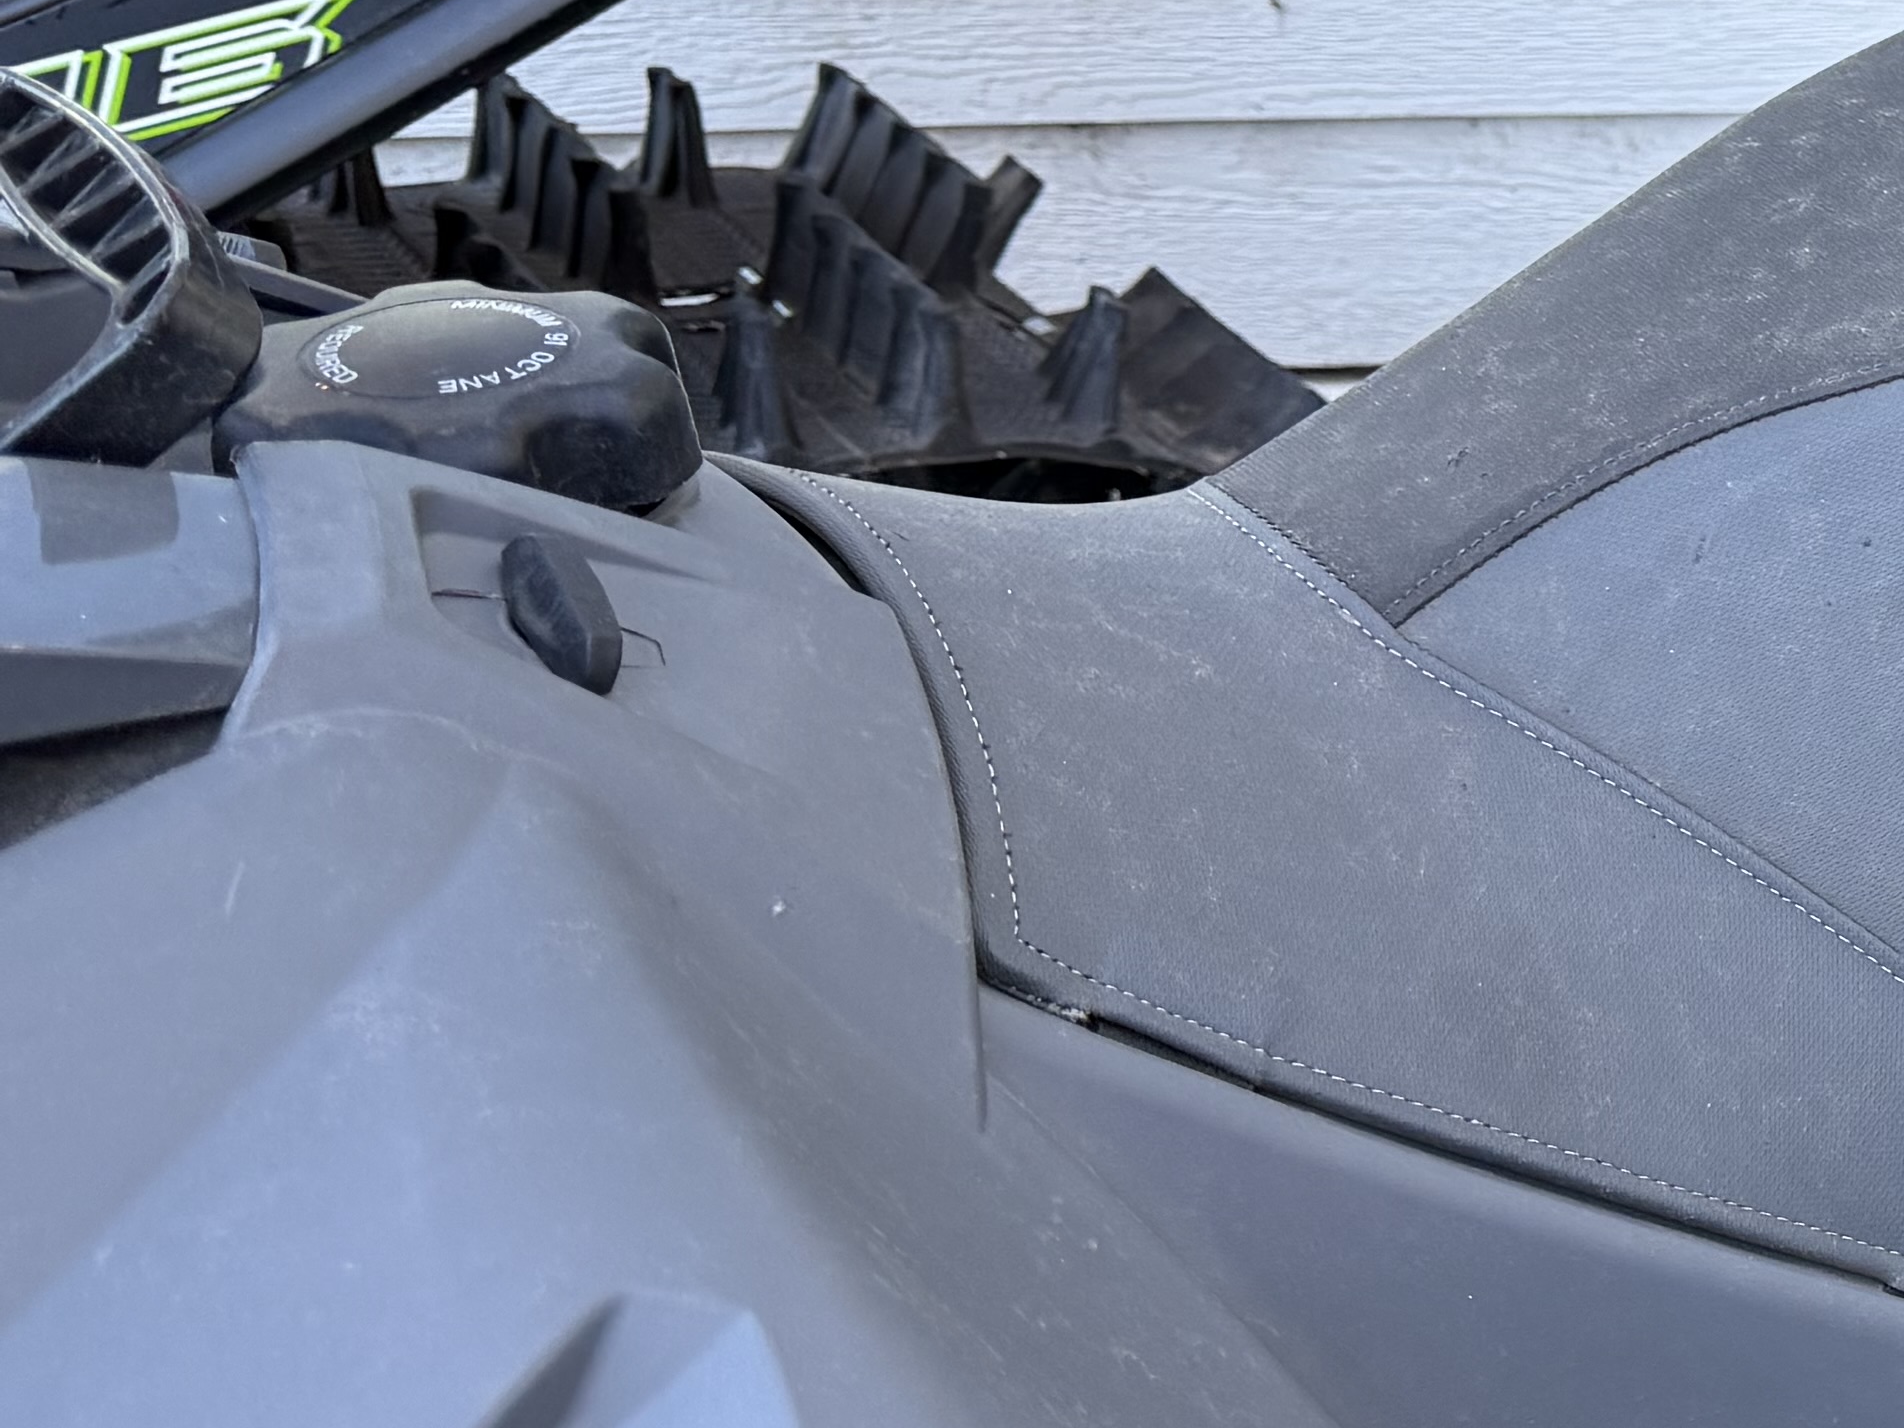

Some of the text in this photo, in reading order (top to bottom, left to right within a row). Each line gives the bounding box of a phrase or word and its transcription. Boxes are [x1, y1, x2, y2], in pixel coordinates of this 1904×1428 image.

[315, 324, 364, 384] REQUIRED
[543, 331, 570, 348] 91
[437, 351, 556, 396] OCTANE
